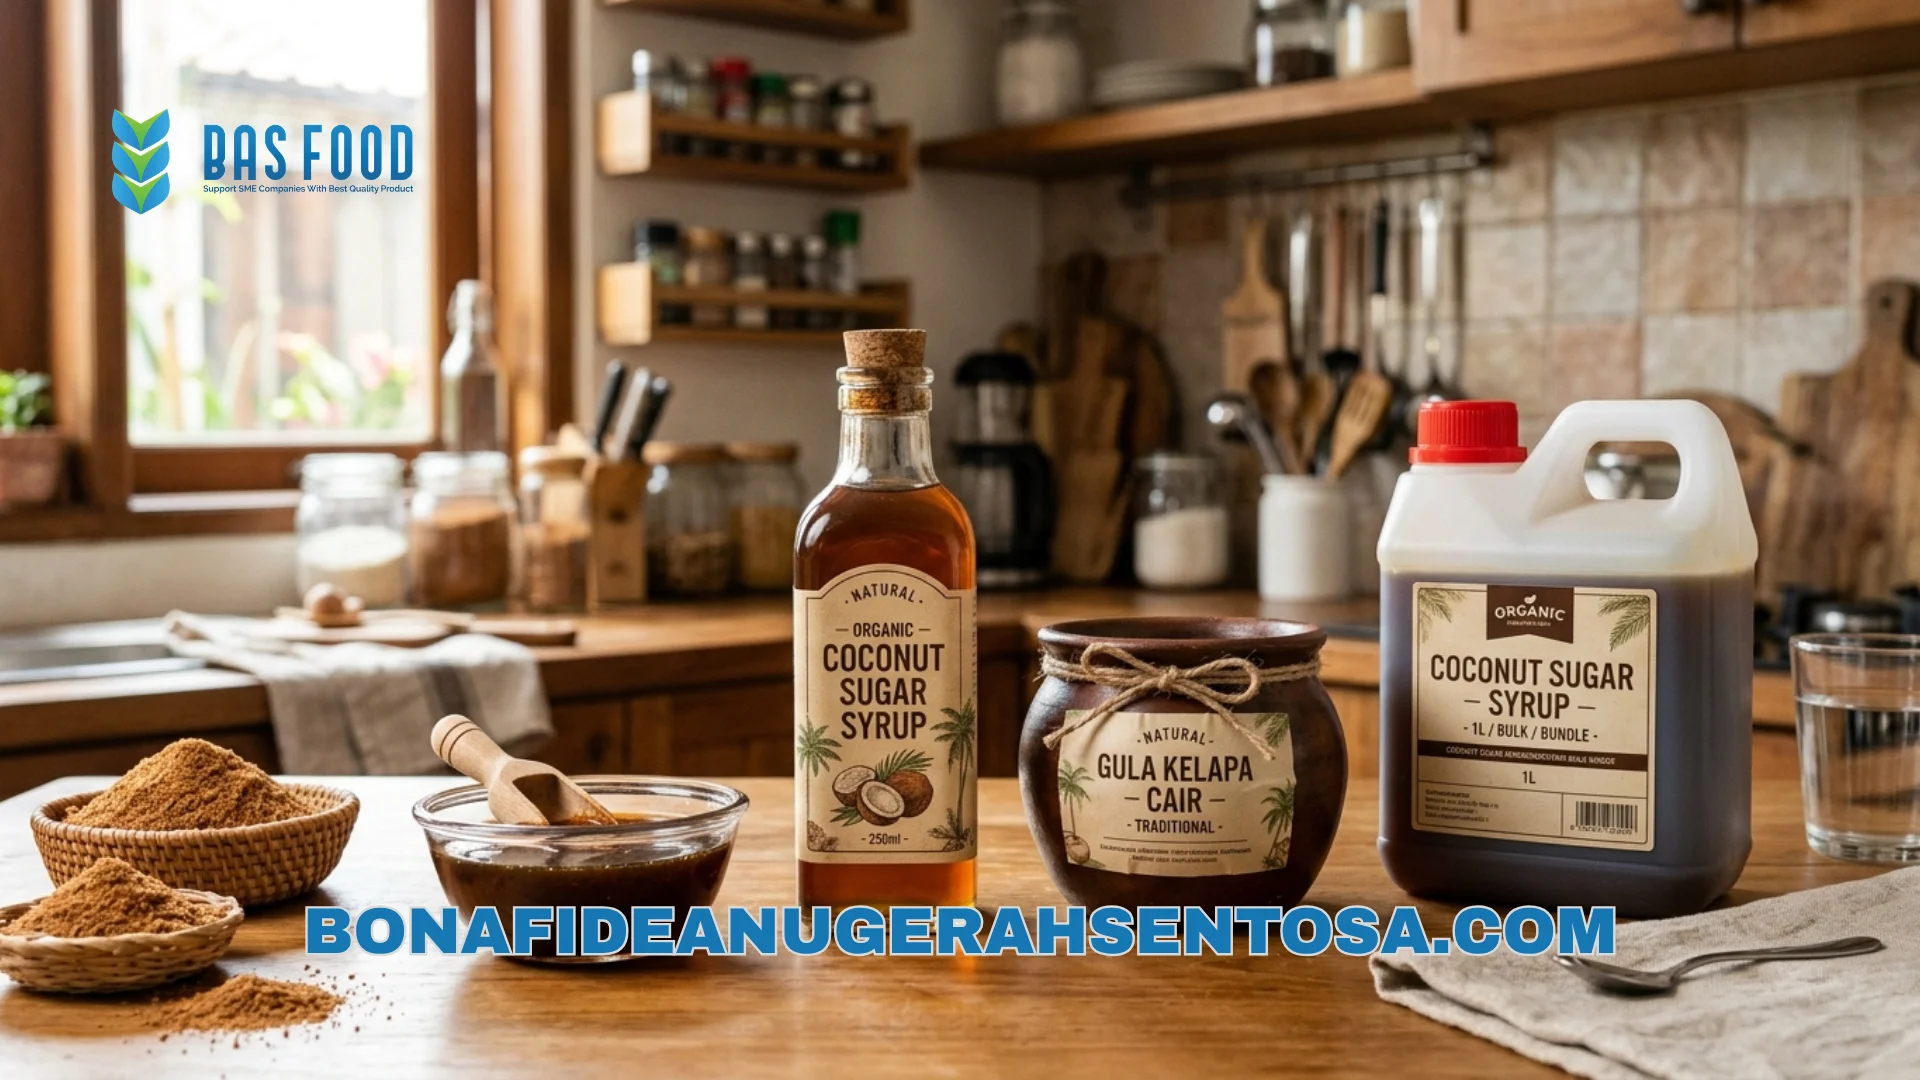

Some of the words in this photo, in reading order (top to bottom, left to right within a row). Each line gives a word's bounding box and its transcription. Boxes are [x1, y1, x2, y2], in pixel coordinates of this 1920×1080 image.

[851, 583, 915, 603] NATURAL
[1494, 604, 1566, 621] ORGANIC
[853, 622, 914, 637] ORGANIC
[823, 643, 945, 672] COCONUT
[1430, 654, 1543, 686] COCONUT
[1549, 660, 1634, 691] SUGAR
[839, 677, 927, 706] SUGAR
[1488, 689, 1570, 720] SYRUP
[841, 711, 927, 740] SYRUP
[1472, 722, 1486, 737] 1L
[1498, 723, 1529, 739] BULK
[1540, 726, 1590, 742] BUNDLE
[1143, 727, 1206, 746] NATURAL
[1097, 753, 1157, 782] GULA
[1163, 755, 1254, 783] KELAPA
[1522, 770, 1536, 784] 1L
[1147, 786, 1203, 814] CAIR
[1134, 819, 1215, 834] TRADITIONAL
[868, 833, 900, 845] 250ml
